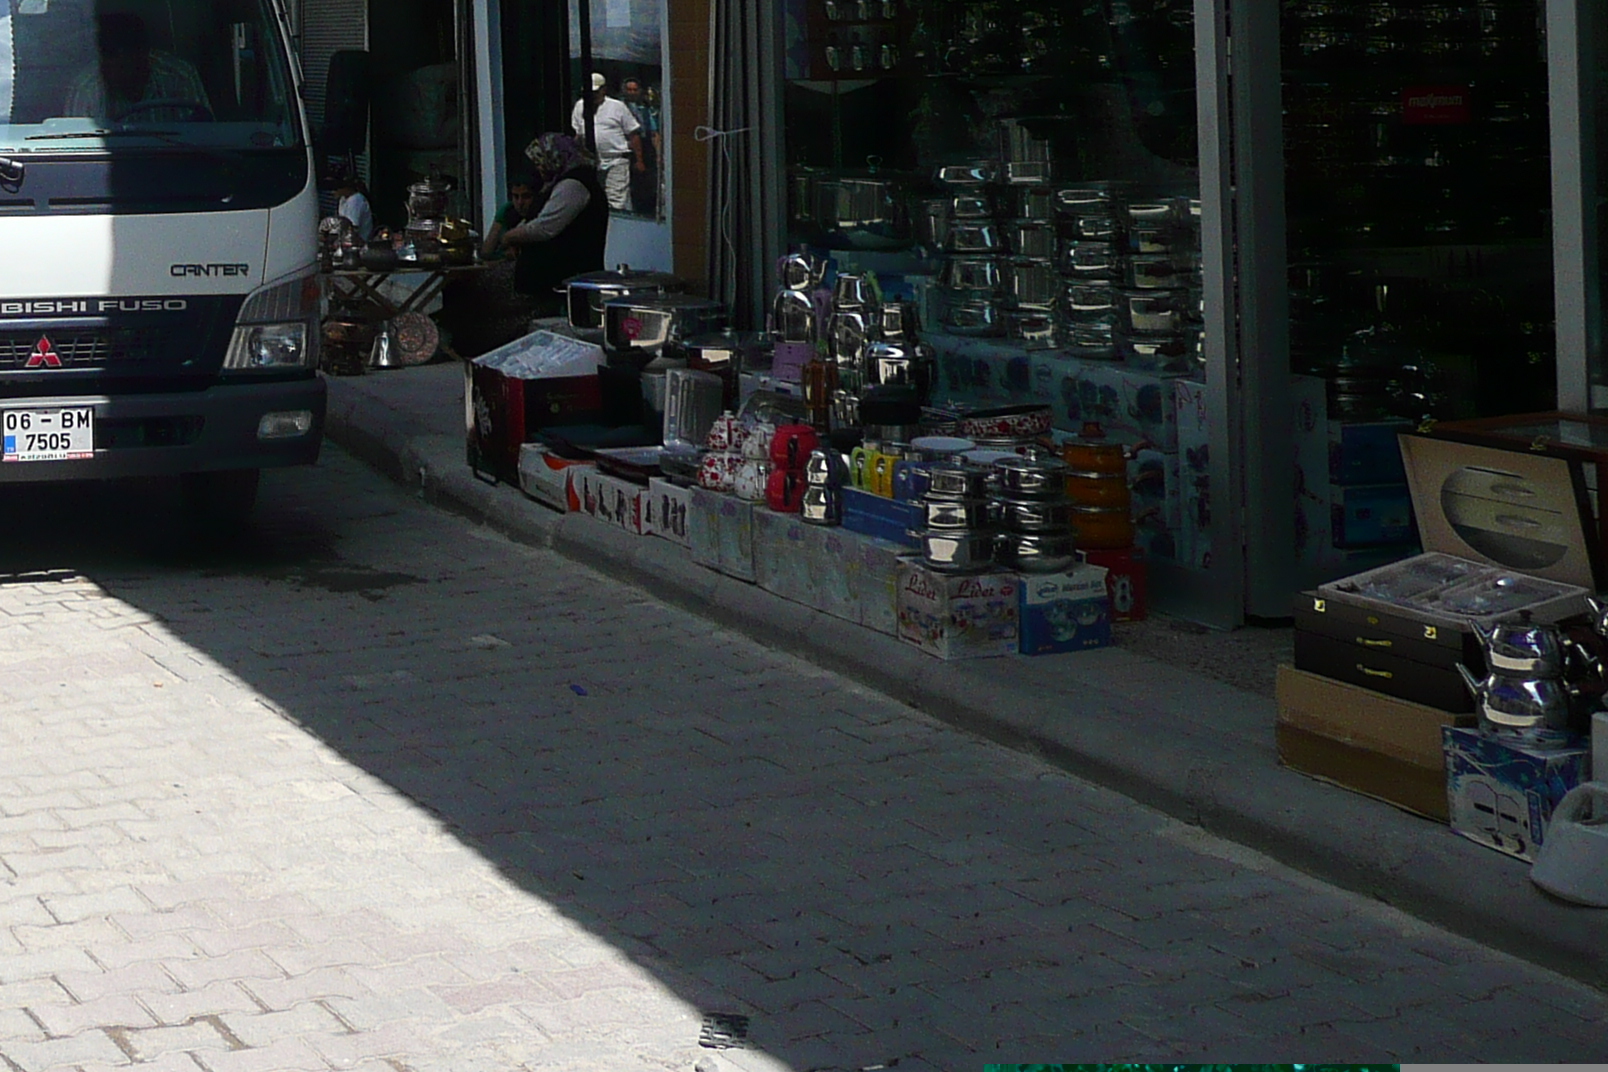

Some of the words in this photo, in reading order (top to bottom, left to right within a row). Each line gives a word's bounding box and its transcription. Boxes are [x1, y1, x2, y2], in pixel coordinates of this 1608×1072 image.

[170, 262, 249, 278] CANTER
[97, 298, 187, 312] FUSO
[6, 412, 31, 431] 06
[61, 409, 90, 429] BM
[25, 432, 71, 451] 7505
